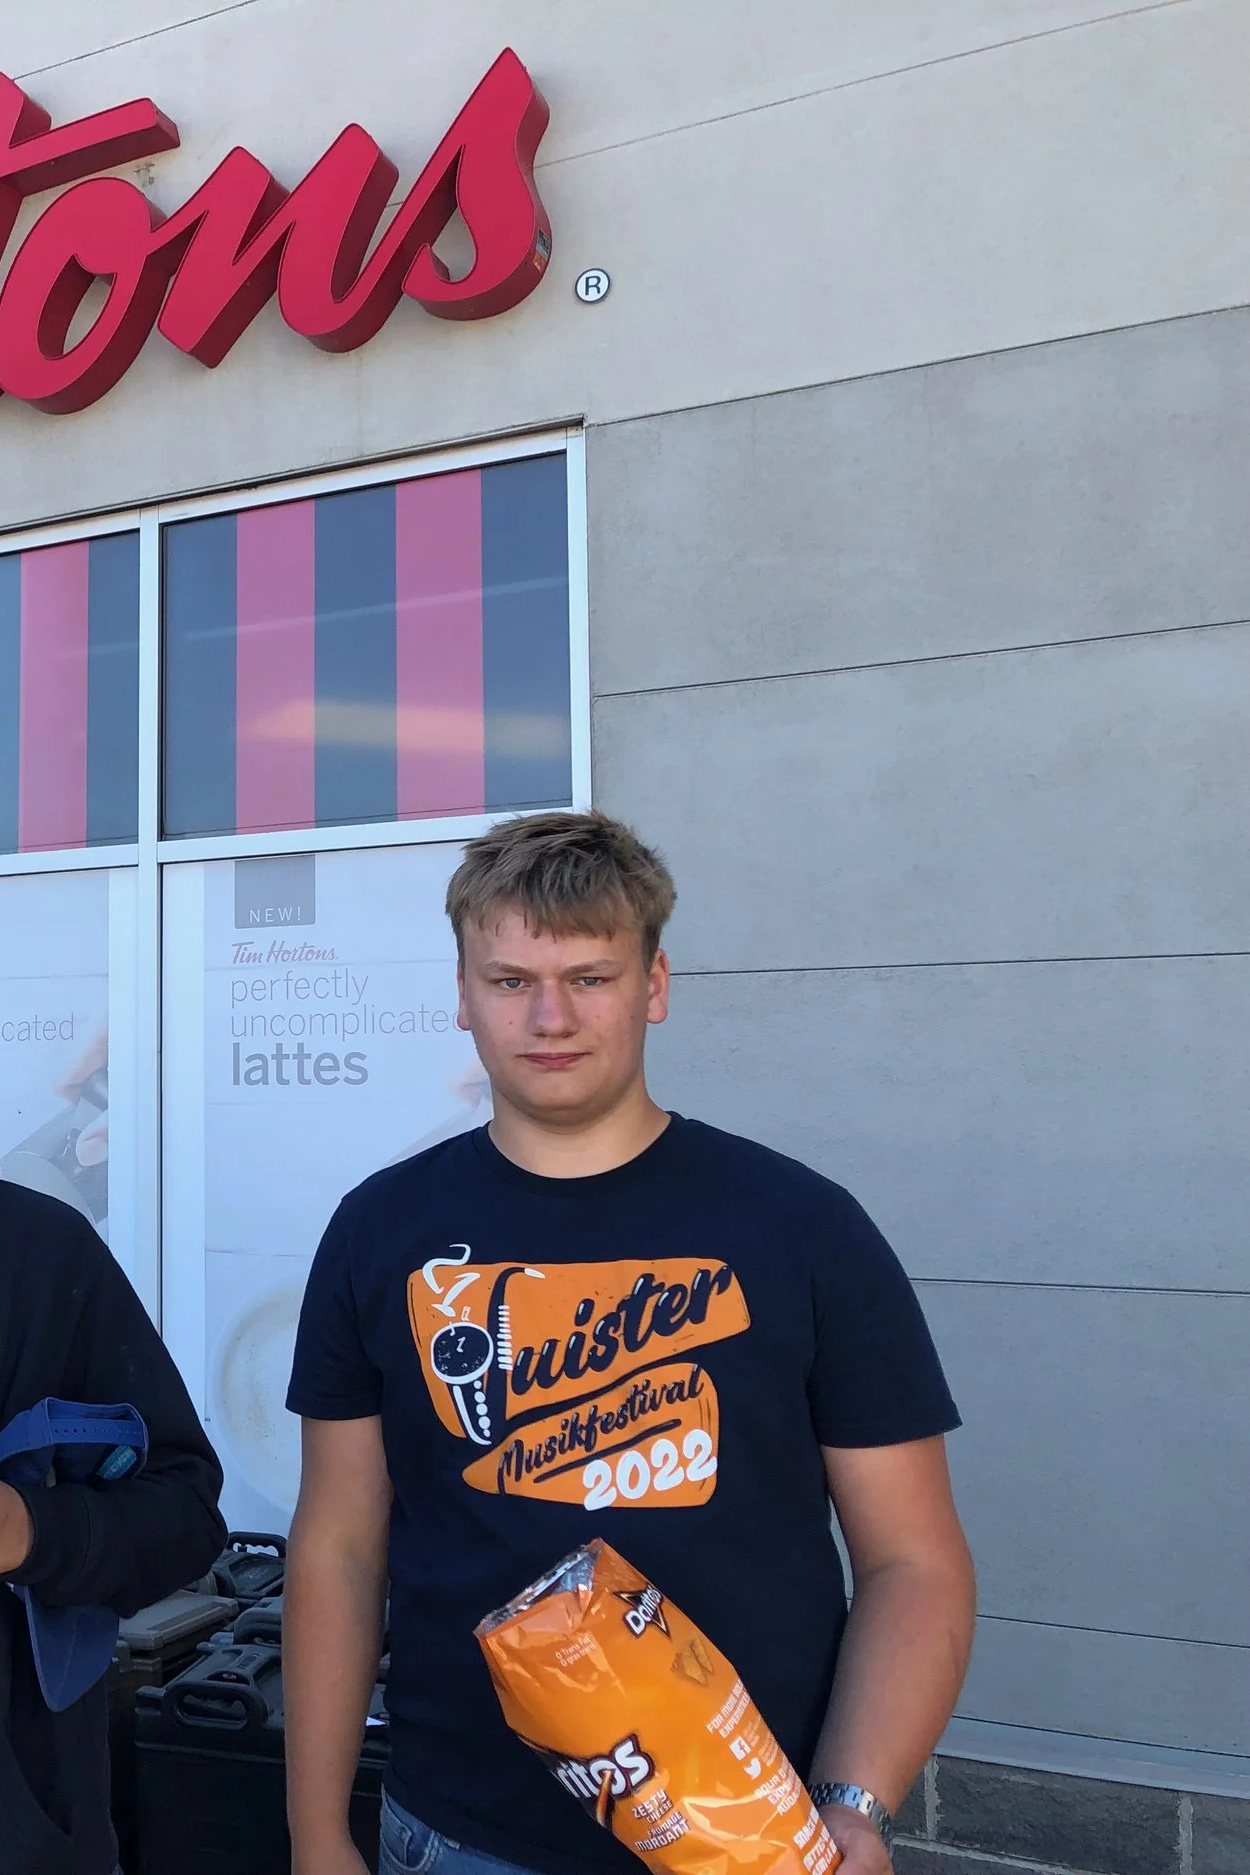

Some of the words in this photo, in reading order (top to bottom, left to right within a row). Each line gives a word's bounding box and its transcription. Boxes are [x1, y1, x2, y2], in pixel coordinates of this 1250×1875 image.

[249, 906, 301, 923] NEW!
[231, 941, 262, 964] Tim
[231, 968, 369, 1009] perfectly
[232, 1042, 369, 1086] lattes
[497, 1363, 704, 1494] Musikfestival
[582, 1429, 717, 1511] 2022
[706, 1714, 724, 1734] FOR
[556, 1738, 650, 1799] ritos
[630, 1789, 668, 1819] ZESTY
[646, 1799, 673, 1824] CHEESE
[634, 1817, 691, 1852] MORDANT
